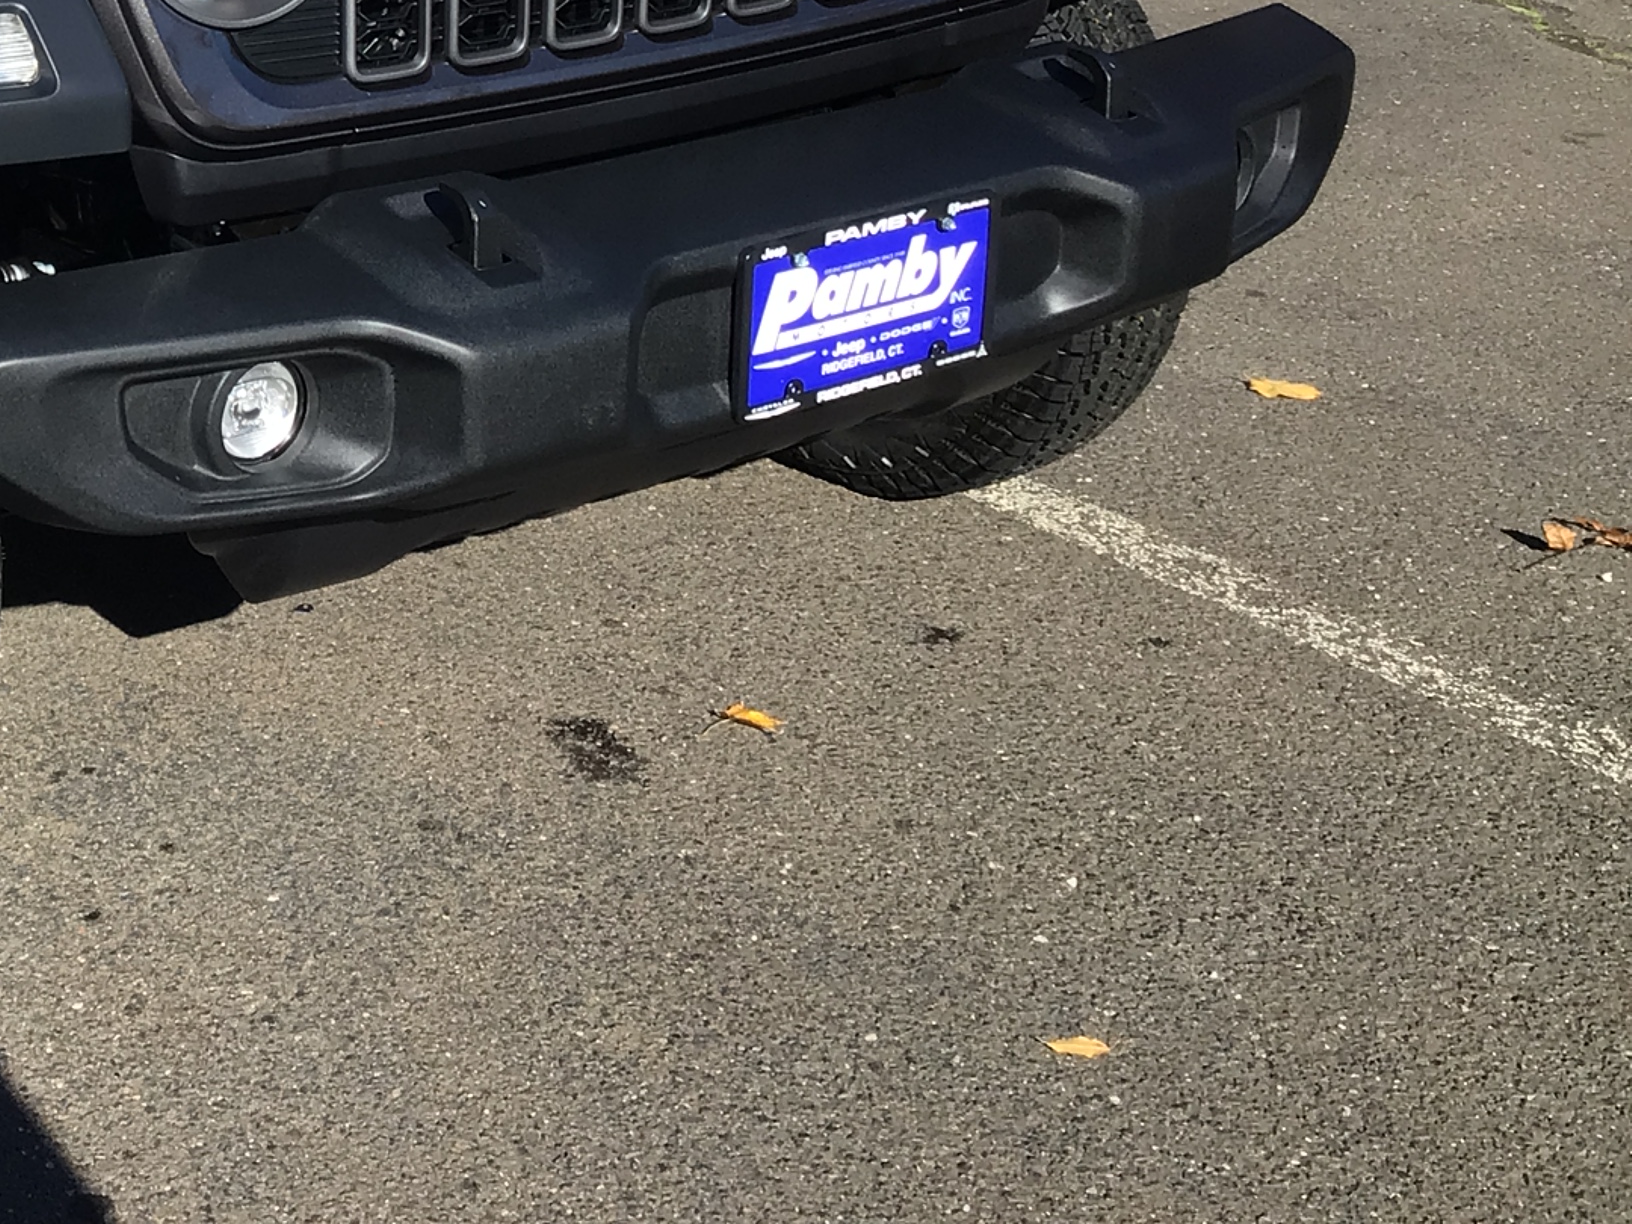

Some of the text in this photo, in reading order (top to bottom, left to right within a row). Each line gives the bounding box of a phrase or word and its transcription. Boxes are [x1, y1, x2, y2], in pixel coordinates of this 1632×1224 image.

[824, 208, 928, 246] PAMBY
[760, 245, 788, 261] Jeep
[752, 233, 978, 356] Pamby
[831, 338, 867, 358] Jeep
[879, 319, 933, 342] DODGE
[821, 348, 887, 376] RIDGEFIELD,
